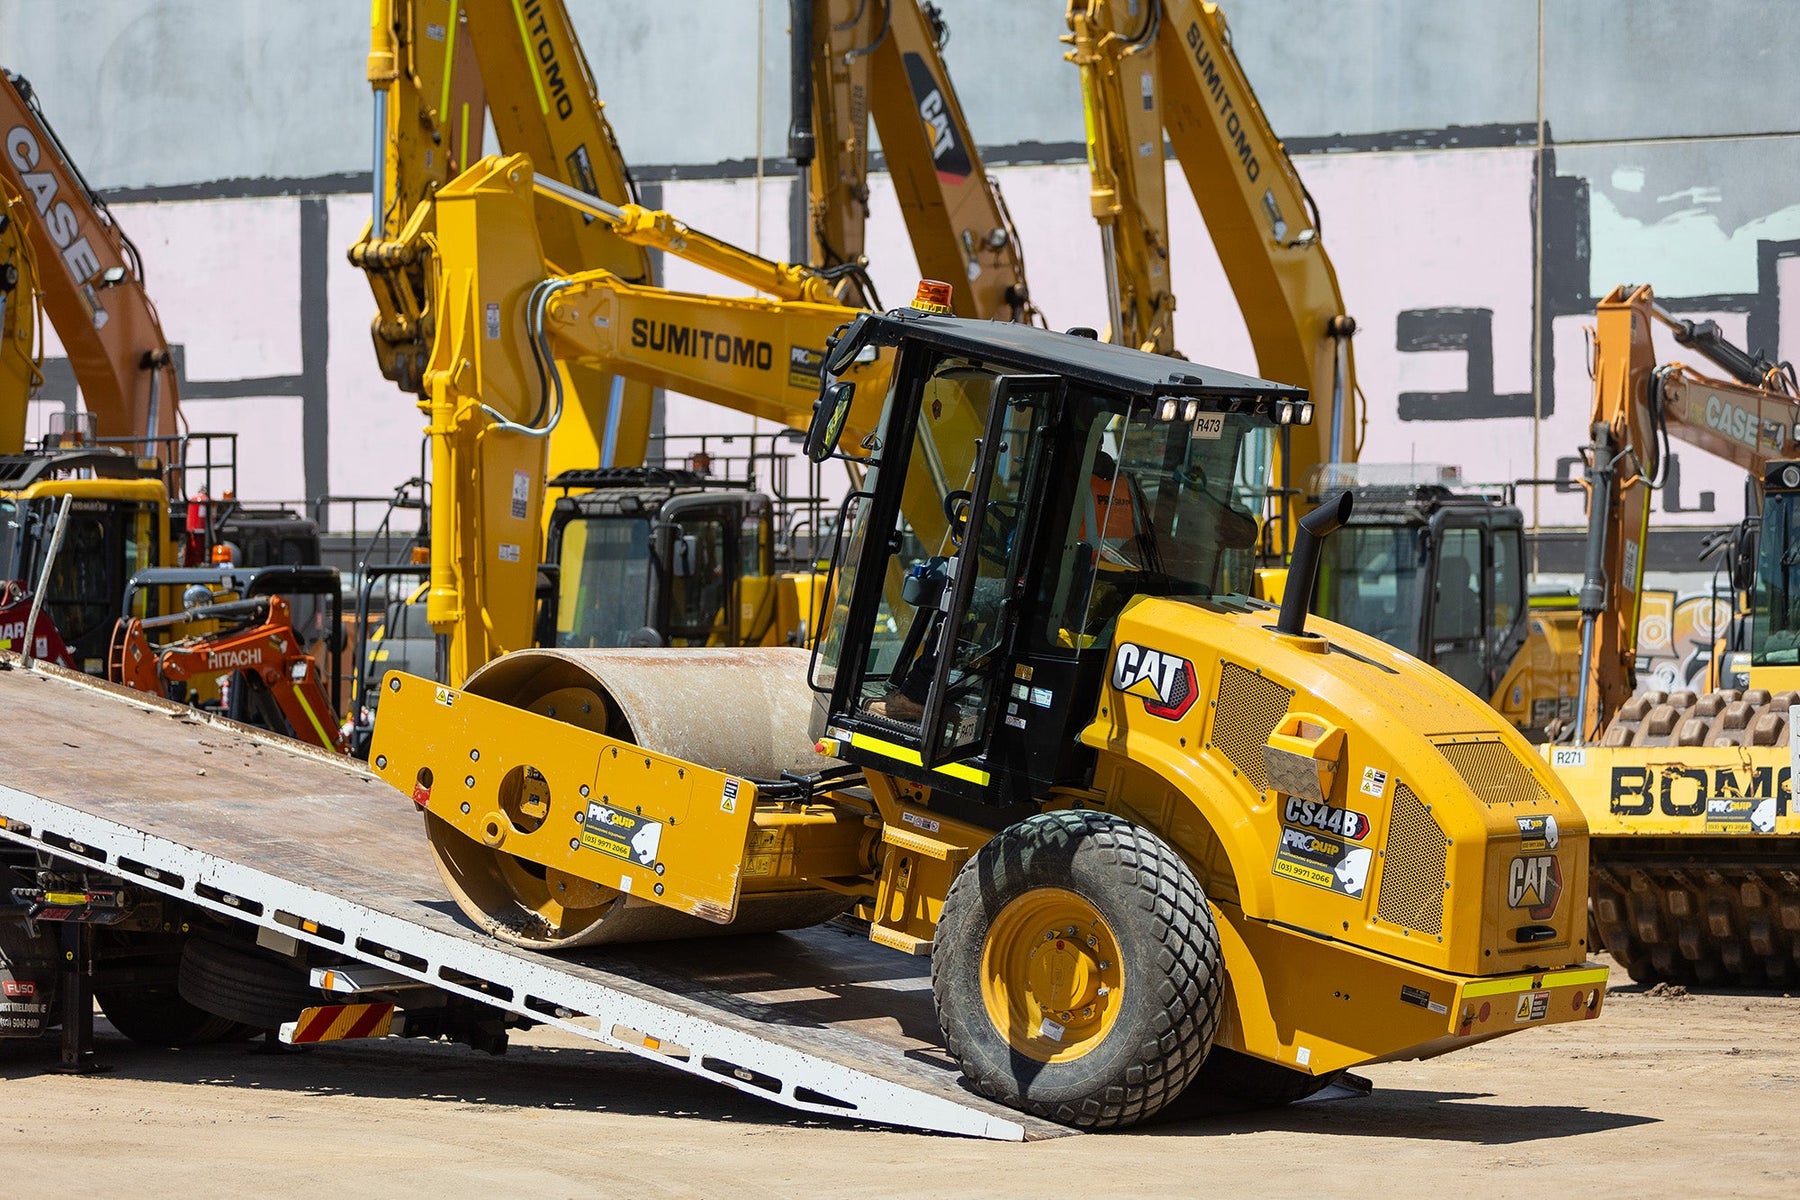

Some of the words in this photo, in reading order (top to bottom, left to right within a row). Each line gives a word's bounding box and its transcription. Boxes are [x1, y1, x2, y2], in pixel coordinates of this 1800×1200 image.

[523, 0, 573, 121] ITOMO
[920, 88, 955, 161] CAT
[1186, 21, 1260, 184] SUMITOMO
[6, 125, 101, 286] CASE
[631, 317, 772, 371] SUMITOMO
[1196, 418, 1221, 433] R473
[1705, 395, 1760, 447] CASE
[0, 621, 25, 639] AR
[208, 648, 262, 669] HITACHI
[1112, 643, 1184, 704] CAT
[1556, 752, 1582, 764] R271
[1285, 796, 1359, 837] CS44B
[584, 834, 597, 845] (03)
[597, 838, 612, 849] 9971
[612, 844, 628, 855] 2066
[1277, 861, 1293, 873] (03)
[1293, 866, 1310, 878] 9971
[1310, 871, 1330, 883] 2066
[1508, 856, 1552, 907] CAT
[7, 984, 34, 994] FUSO
